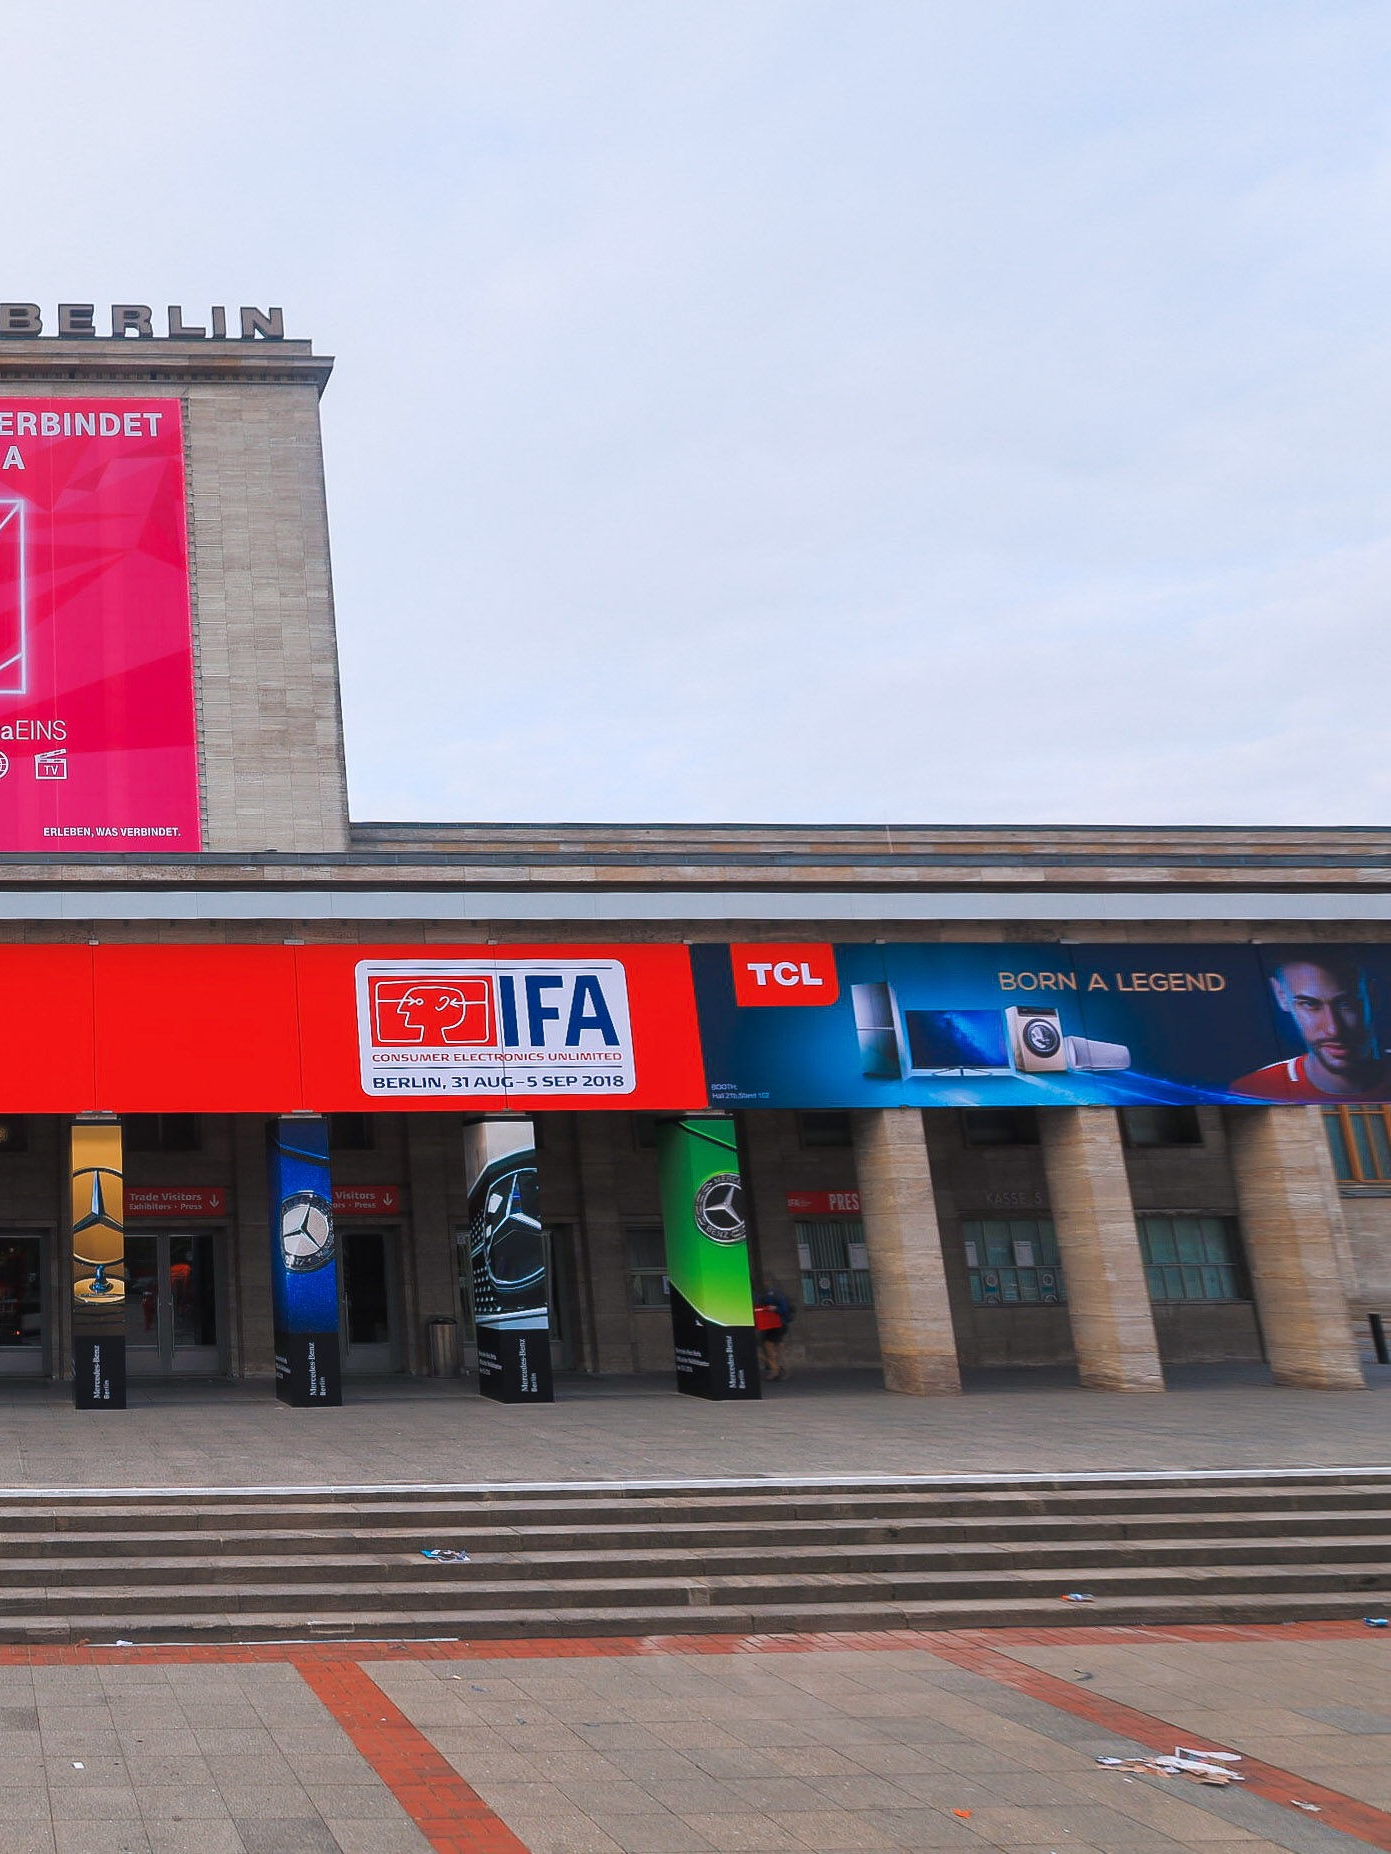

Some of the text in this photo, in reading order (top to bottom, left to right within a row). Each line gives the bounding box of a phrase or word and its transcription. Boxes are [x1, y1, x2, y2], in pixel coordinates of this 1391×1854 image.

[44, 765, 59, 775] TV
[43, 827, 181, 838] ERLEBEN, WAS VERBINDET.
[747, 962, 823, 986] TCL
[998, 972, 1226, 992] BORN A LEGEND
[499, 975, 620, 1047] IFA
[372, 1052, 622, 1062] CONSUMER ELECTRONICS UNLIMITED
[373, 1077, 447, 1090] BERLIN,
[451, 1077, 469, 1088] 31
[543, 1076, 578, 1087] SEP
[582, 1075, 624, 1087] 2018
[130, 1193, 202, 1201] Trade Visitors
[335, 1191, 376, 1199] Visitors
[829, 1193, 859, 1210] PRES
[93, 1345, 101, 1399] Mercedes-Benz
[308, 1342, 317, 1396] Mercedes-Benz
[519, 1339, 529, 1392] Mercedes-Benz
